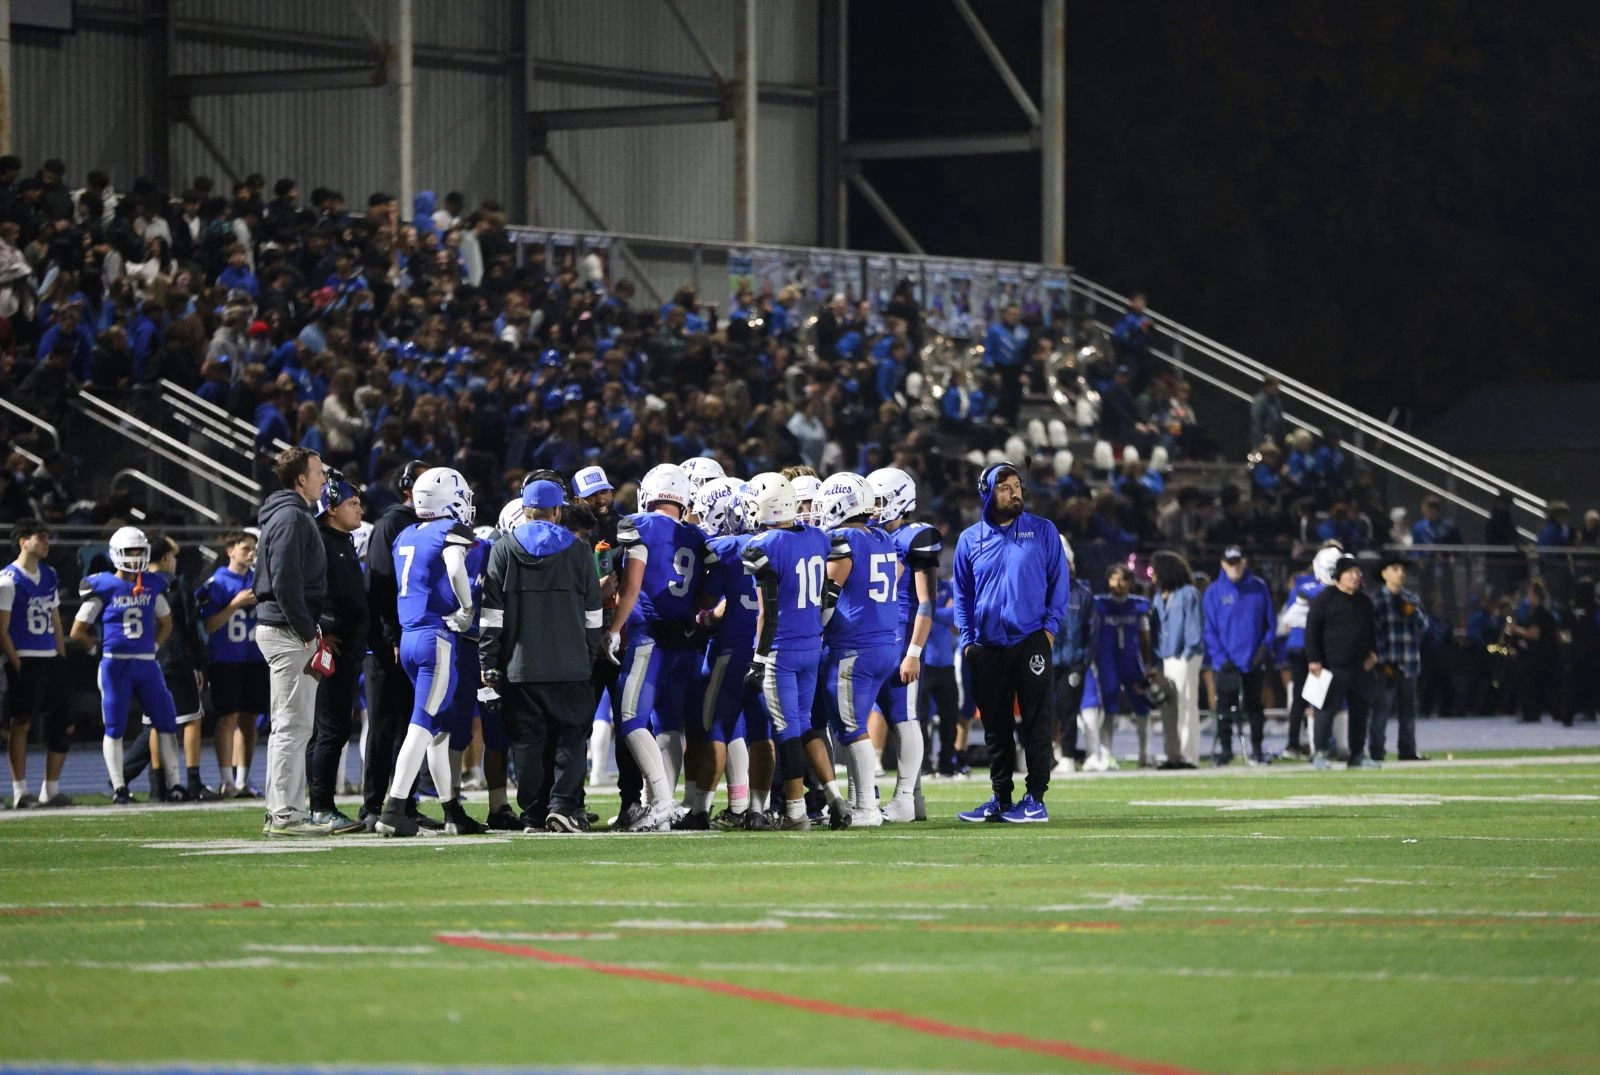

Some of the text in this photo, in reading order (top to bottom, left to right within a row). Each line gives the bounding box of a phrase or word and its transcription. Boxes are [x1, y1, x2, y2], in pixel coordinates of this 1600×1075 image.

[451, 474, 459, 487] 7
[658, 493, 684, 502] Riddell
[701, 487, 732, 506] Celtics
[398, 546, 415, 598] 7
[669, 547, 696, 597] 9
[796, 555, 824, 609] 10
[868, 552, 898, 603] 57
[123, 607, 143, 639] 6
